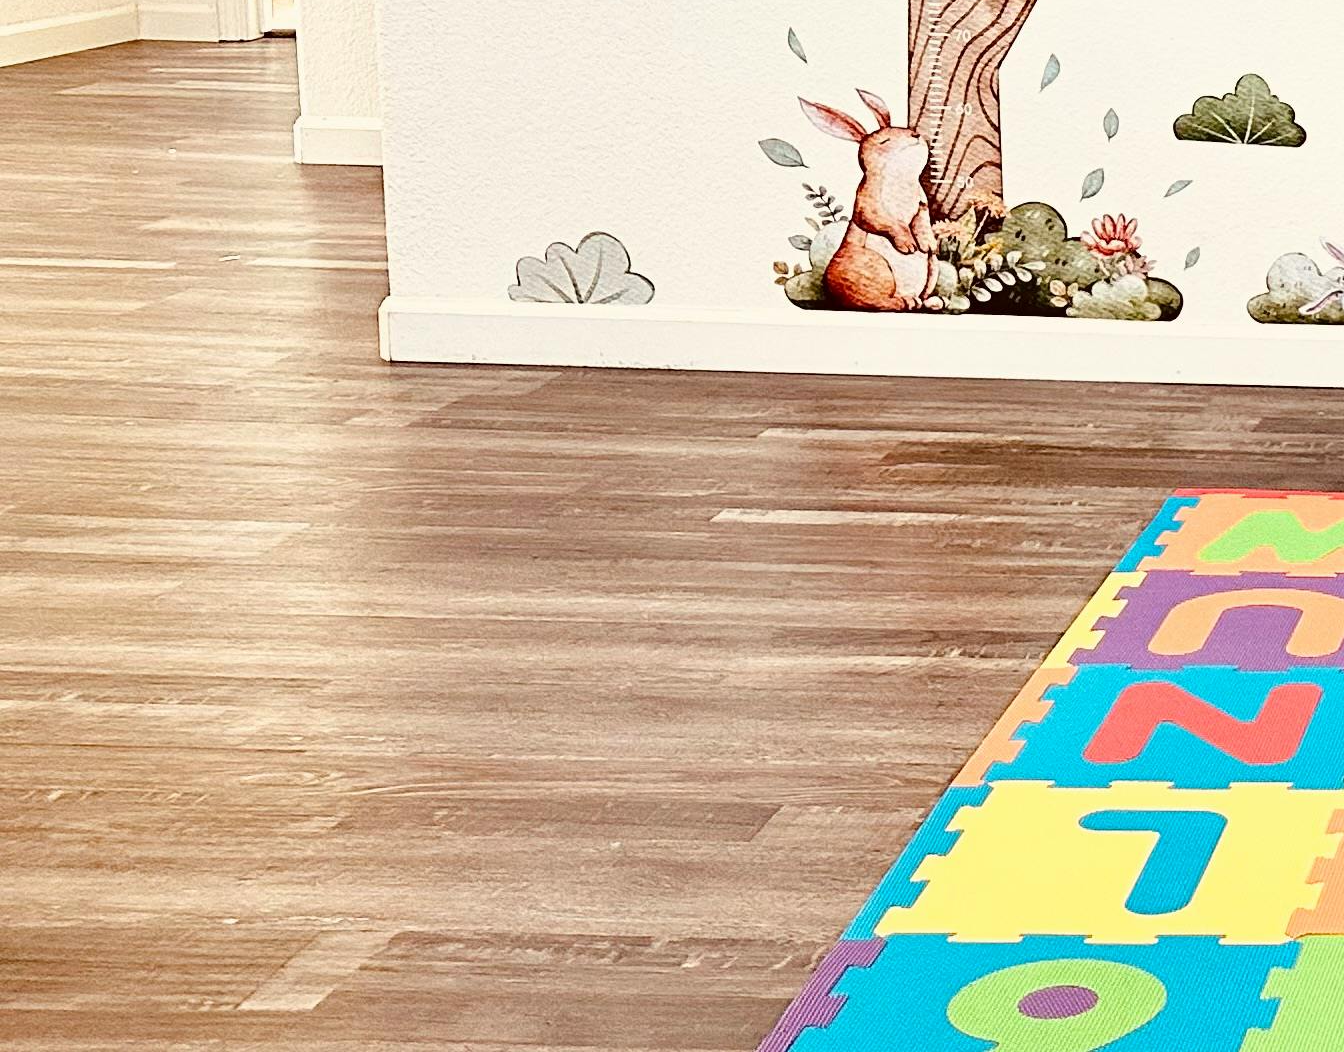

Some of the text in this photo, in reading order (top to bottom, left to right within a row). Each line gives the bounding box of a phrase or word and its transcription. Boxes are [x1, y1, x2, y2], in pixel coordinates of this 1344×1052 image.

[956, 29, 971, 41] 70
[955, 103, 973, 116] 60
[957, 176, 975, 188] 50
[1082, 682, 1324, 765] N
[1079, 810, 1227, 916] L
